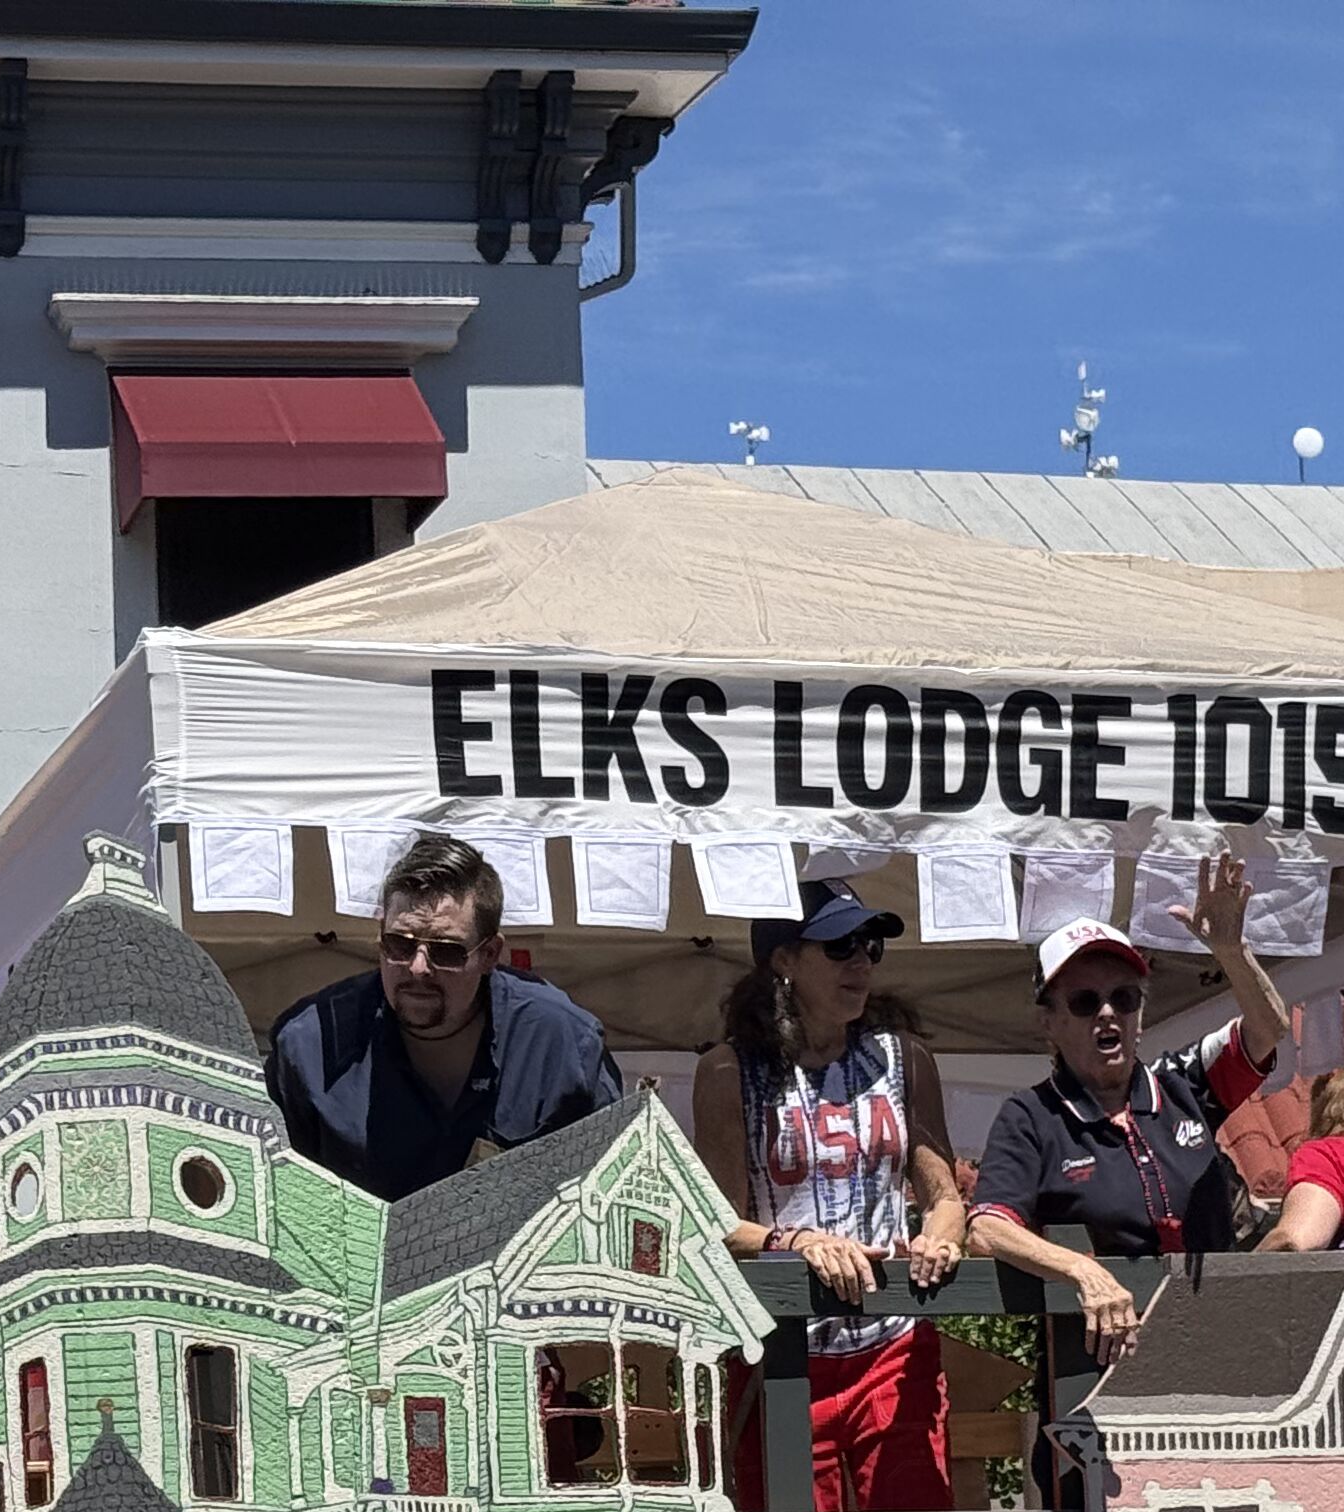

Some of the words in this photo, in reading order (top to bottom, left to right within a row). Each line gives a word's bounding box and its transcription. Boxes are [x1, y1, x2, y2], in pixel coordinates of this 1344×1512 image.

[430, 668, 730, 808] ELKS
[772, 680, 1134, 824] LODGE
[1065, 925, 1111, 941] USA
[766, 1094, 902, 1187] USA
